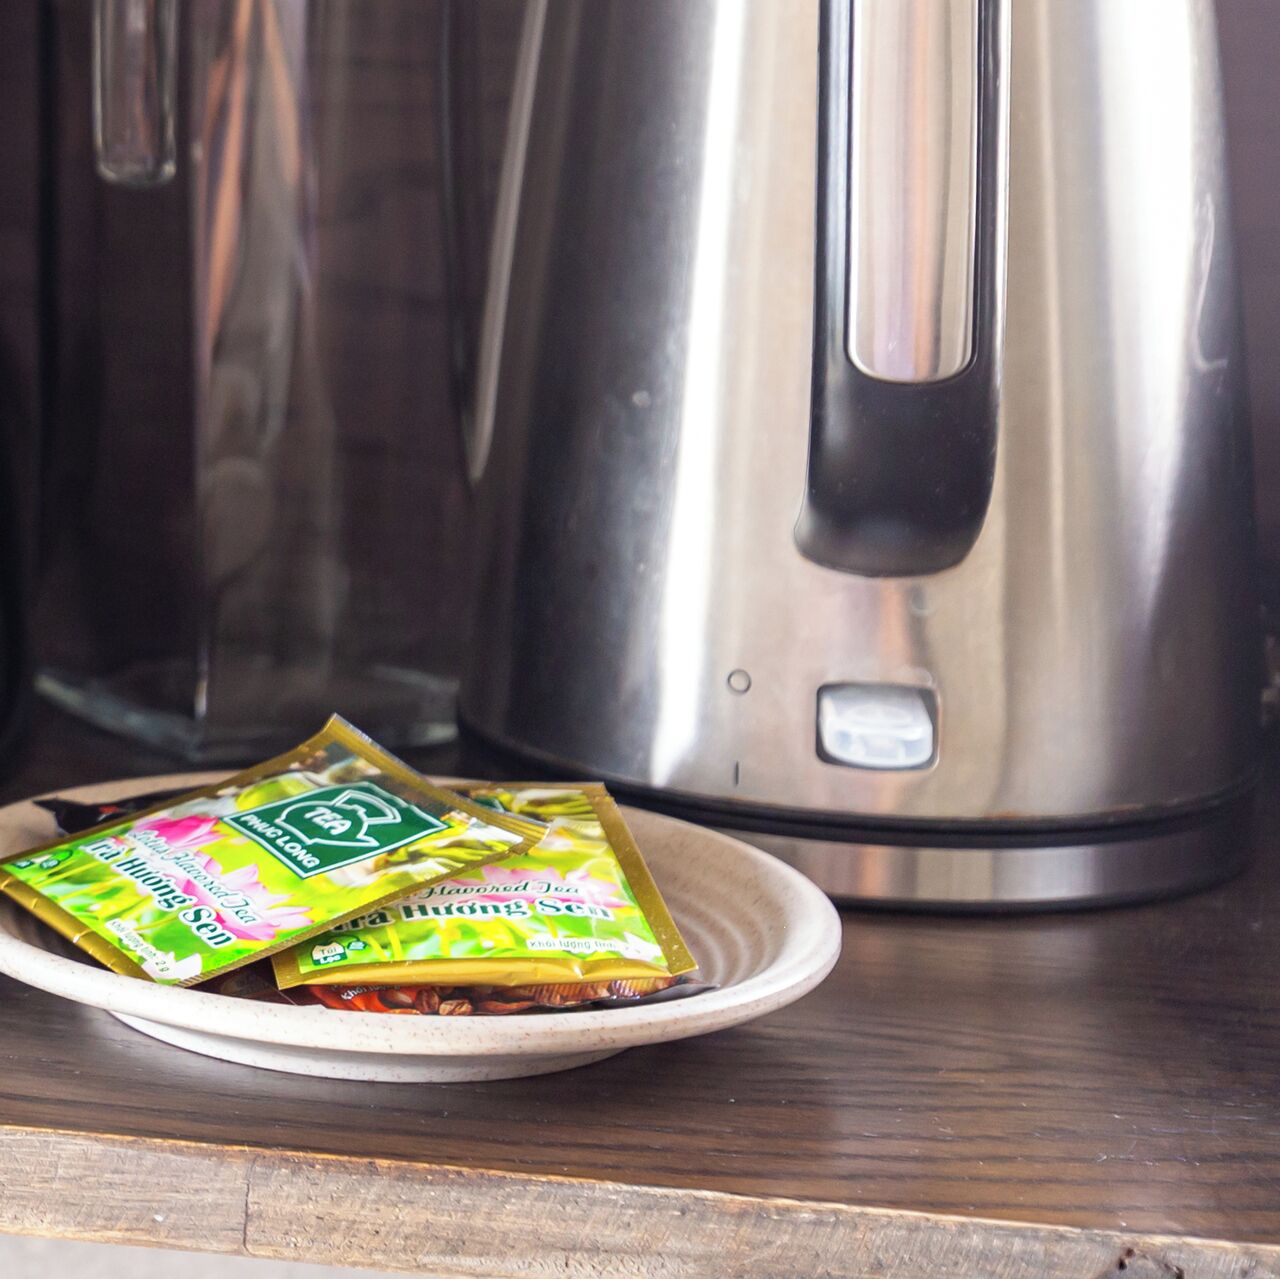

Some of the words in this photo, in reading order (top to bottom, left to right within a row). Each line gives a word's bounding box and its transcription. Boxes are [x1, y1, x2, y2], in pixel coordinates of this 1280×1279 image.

[304, 806, 352, 835] TEA
[275, 834, 320, 869] LONG
[163, 849, 228, 899] Flavored
[219, 896, 258, 924] Tea
[418, 880, 529, 899] Flavored
[533, 881, 580, 894] Tea
[401, 900, 528, 919] Hương
[537, 899, 611, 919] Sen
[182, 906, 233, 946] Sen
